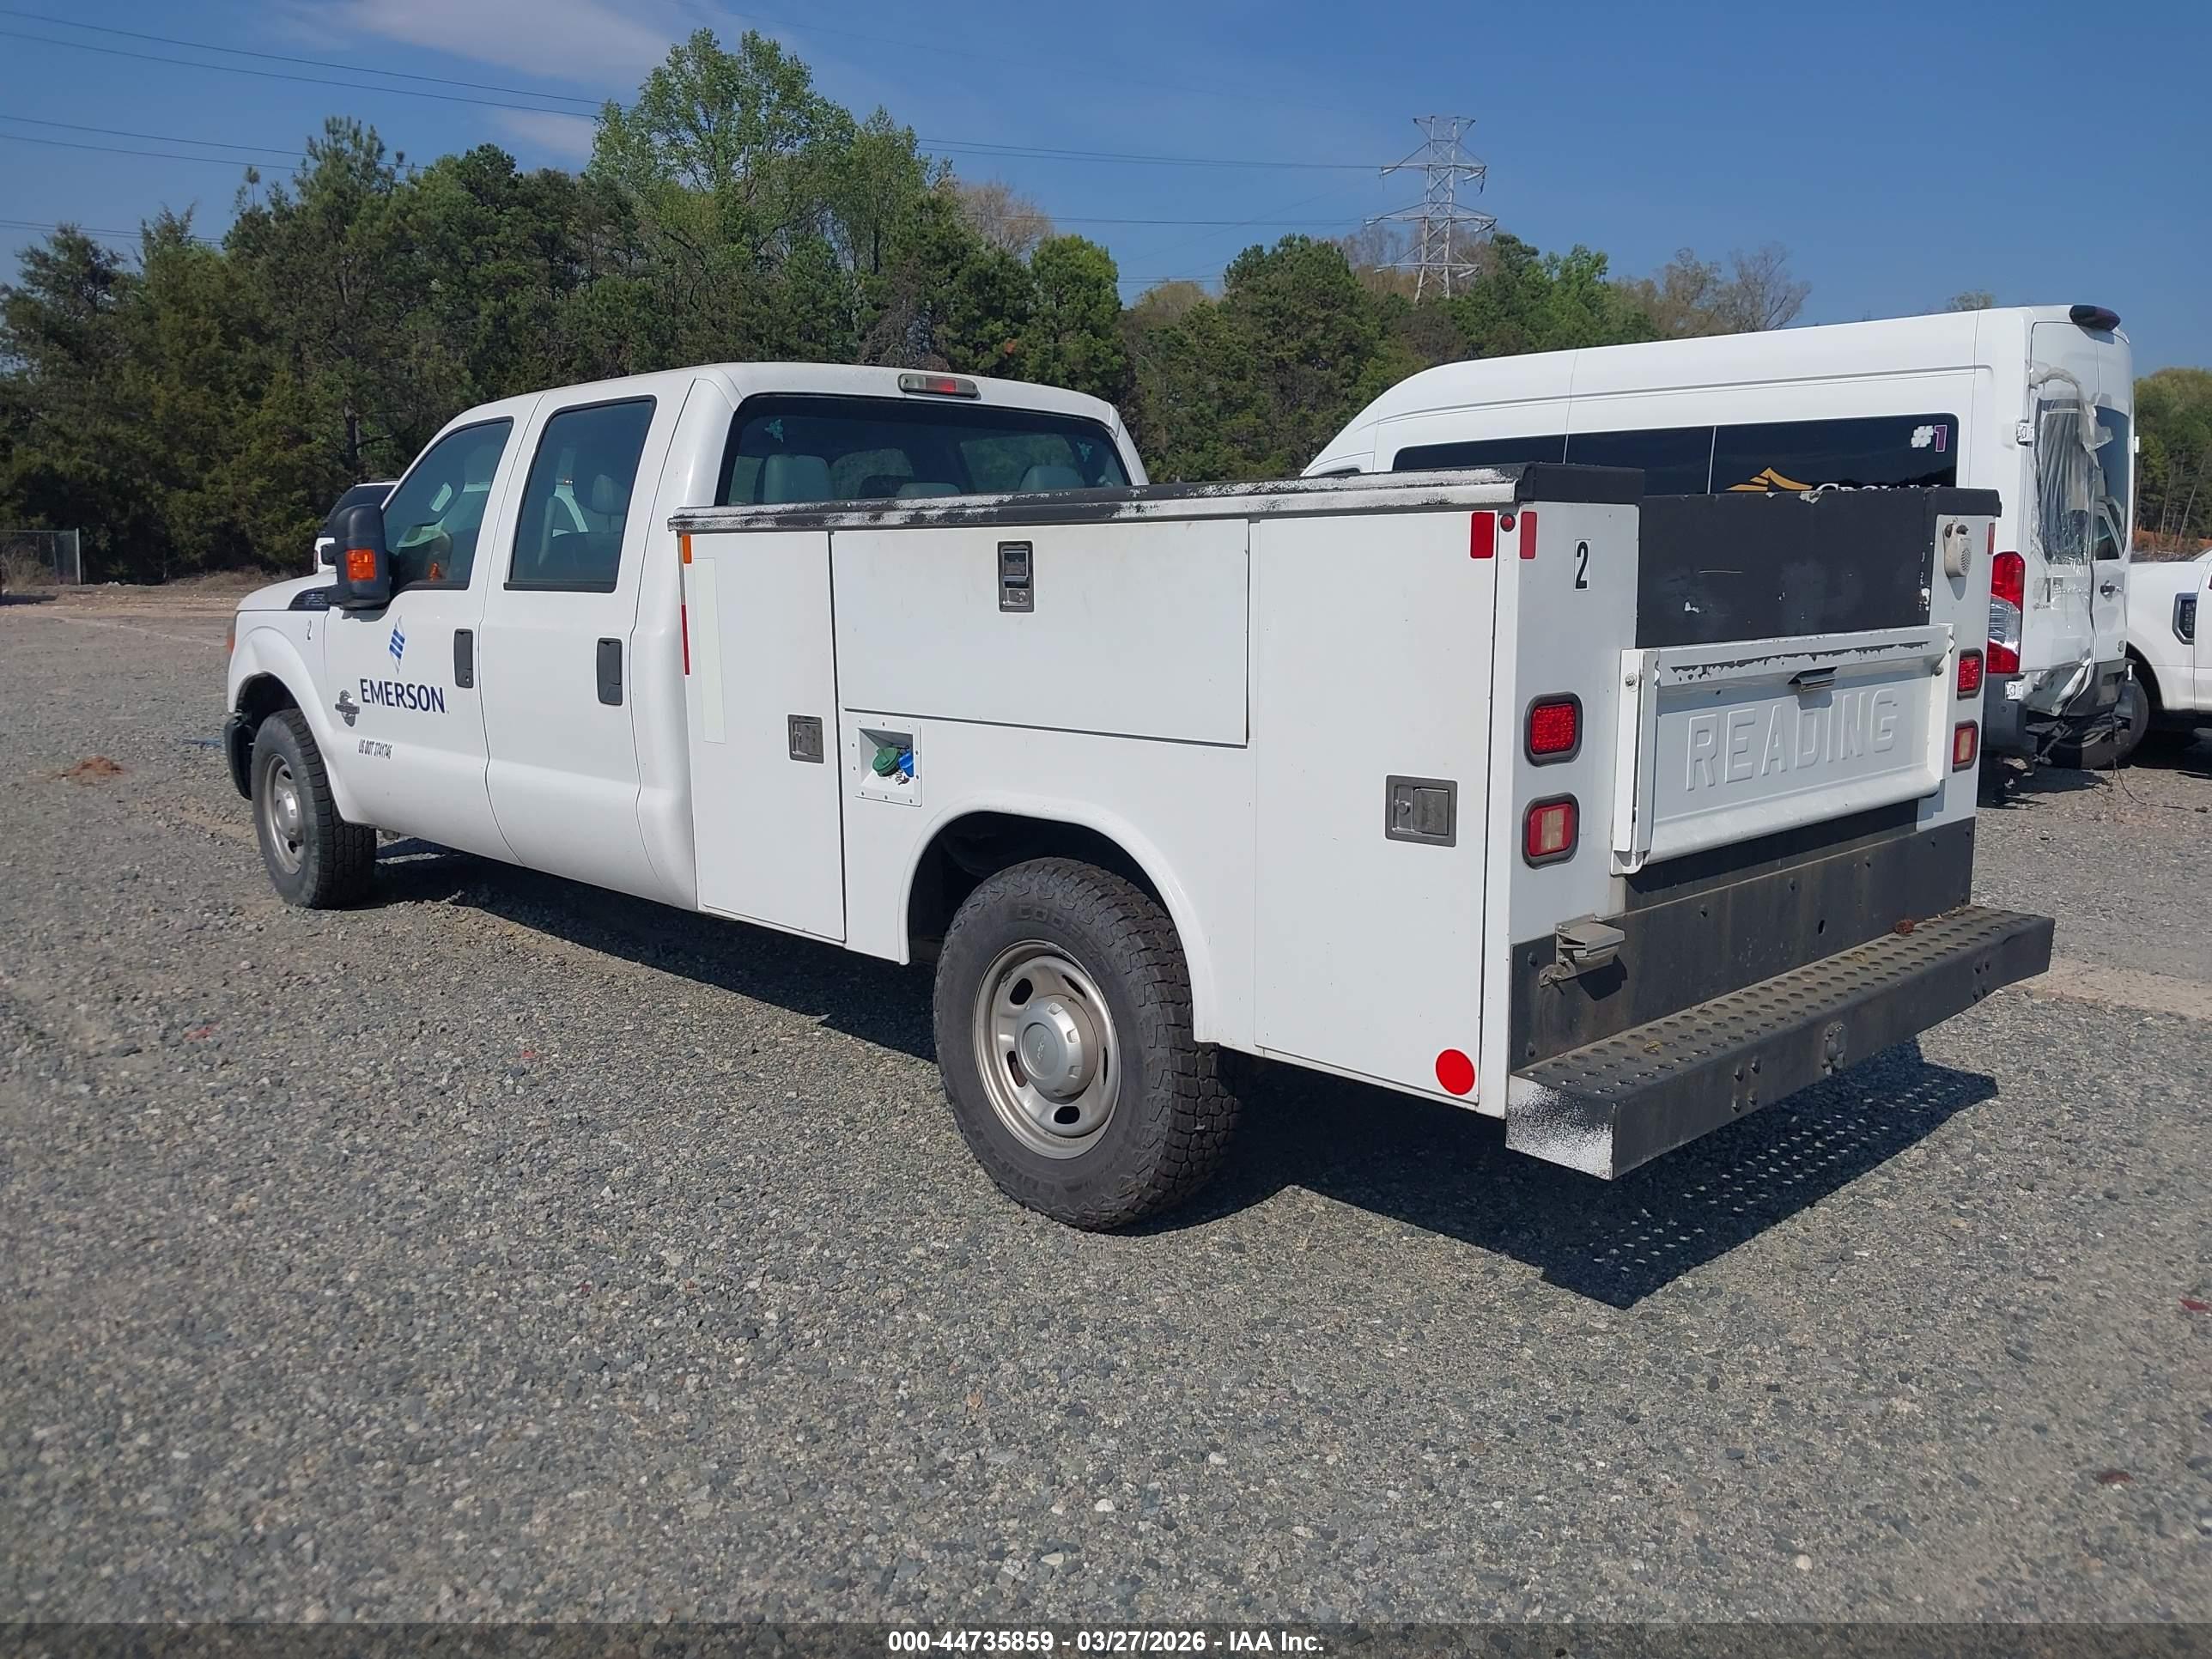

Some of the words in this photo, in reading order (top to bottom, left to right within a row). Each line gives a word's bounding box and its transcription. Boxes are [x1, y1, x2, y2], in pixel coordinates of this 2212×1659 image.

[1911, 425, 1948, 452] #1
[1575, 541, 1589, 589] 2
[360, 678, 446, 714] EMERSON
[358, 738, 366, 754] US
[364, 739, 375, 757] DOT
[1686, 688, 1898, 791] READING
